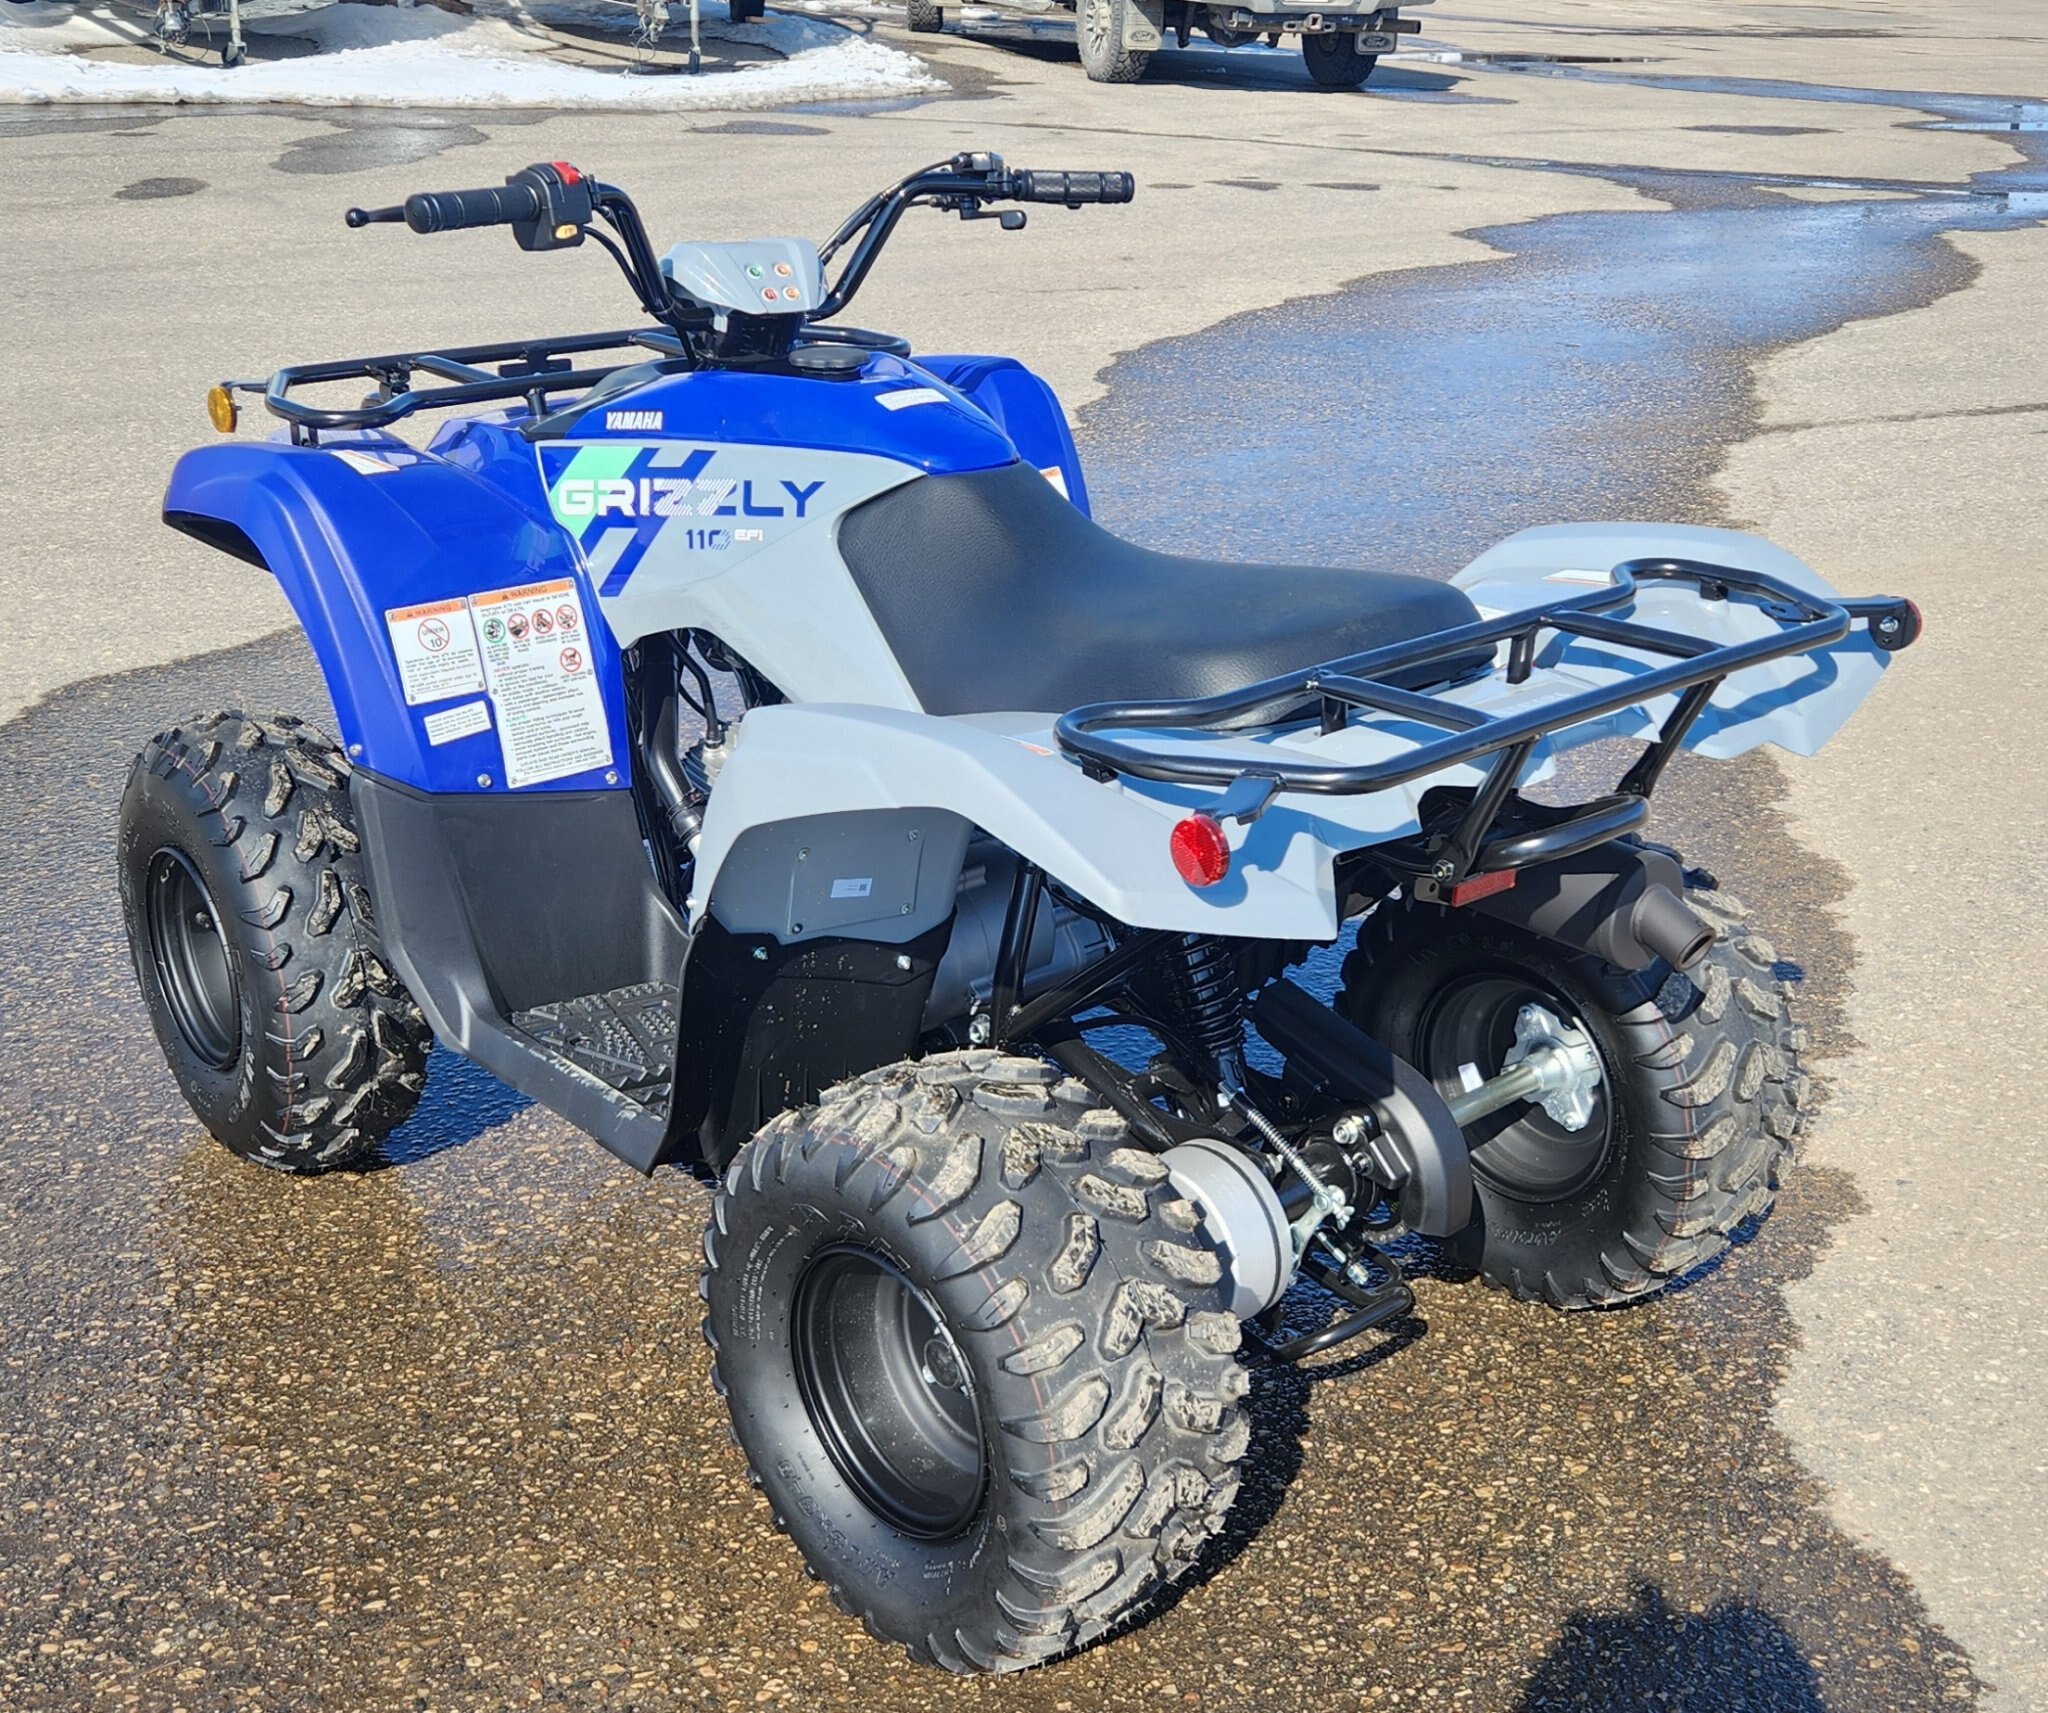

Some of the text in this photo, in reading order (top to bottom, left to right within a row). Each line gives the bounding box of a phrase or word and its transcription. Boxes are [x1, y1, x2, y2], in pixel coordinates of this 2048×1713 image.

[605, 411, 663, 431] YAMAHA
[558, 477, 826, 518] GRIZZLY
[685, 528, 763, 550] 110 EFI
[511, 585, 548, 598] WARNING
[416, 604, 452, 616] WARNING
[430, 637, 443, 648] 10
